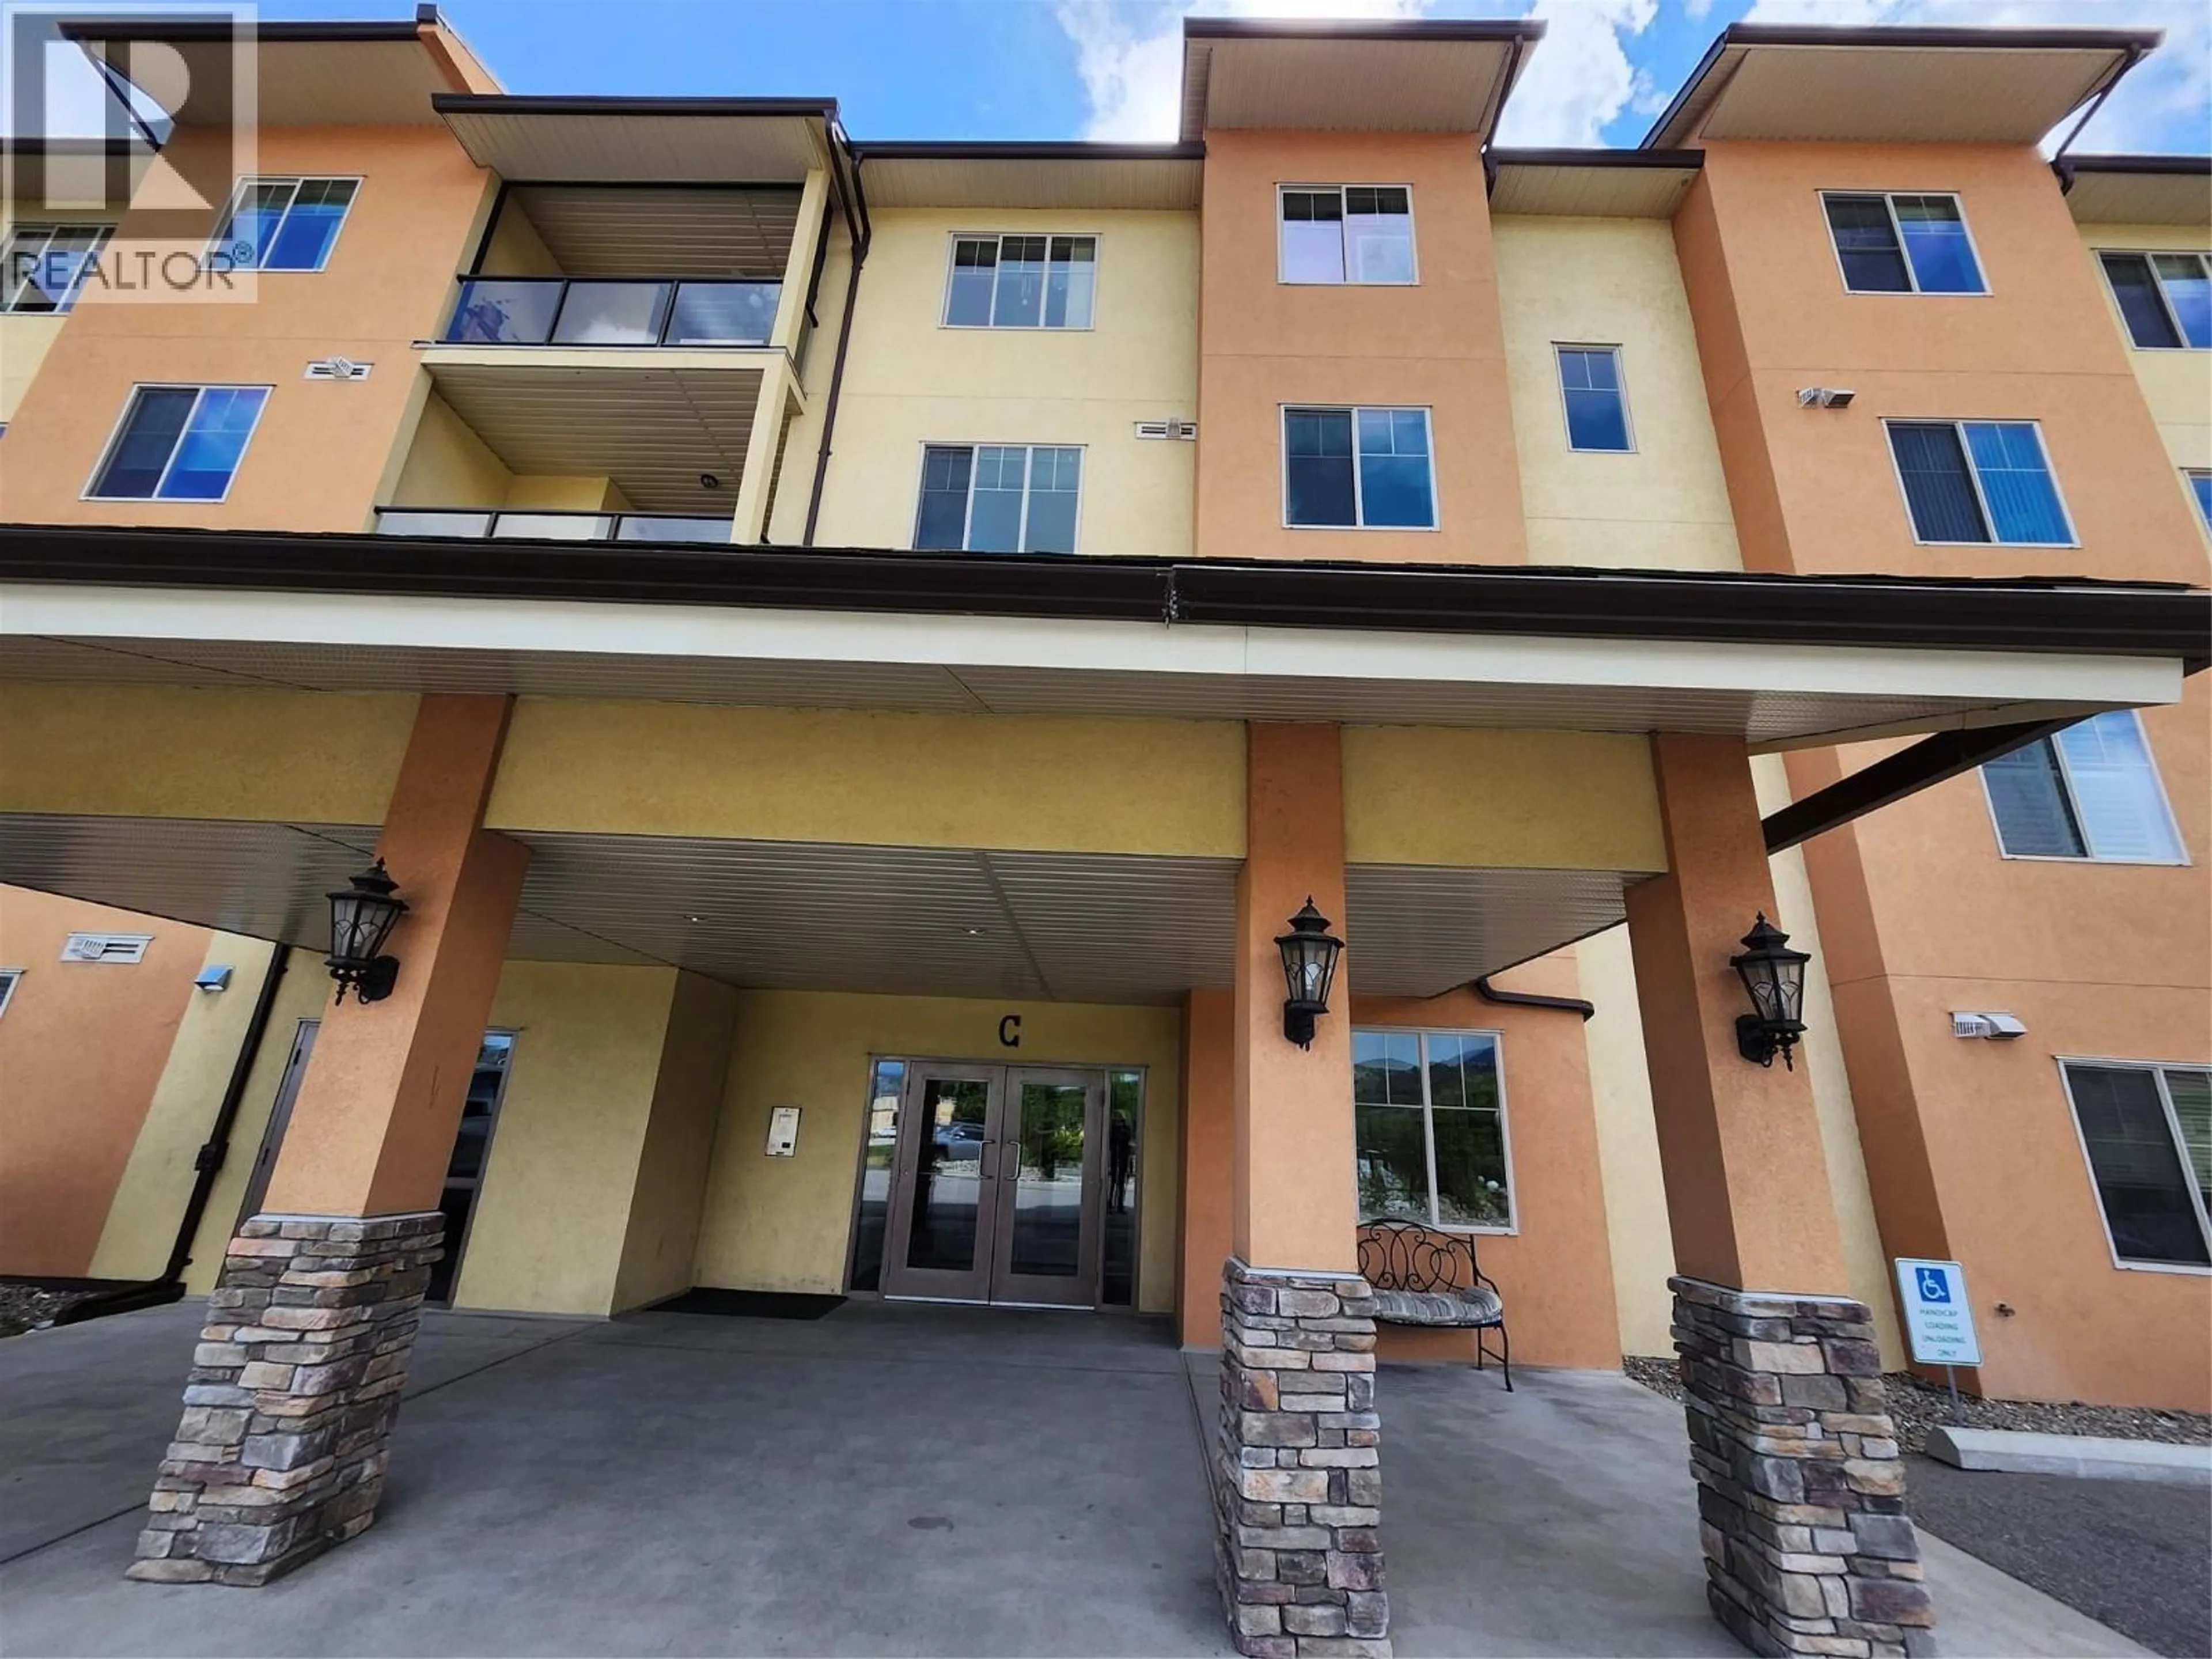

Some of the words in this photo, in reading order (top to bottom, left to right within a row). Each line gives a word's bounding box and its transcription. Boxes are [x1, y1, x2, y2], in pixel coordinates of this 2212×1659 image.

[999, 1014, 1021, 1048] C
[1919, 1308, 1958, 1317] HANDICAP
[1925, 1321, 1959, 1330] LOADING
[1937, 1349, 1957, 1357] ONLY
